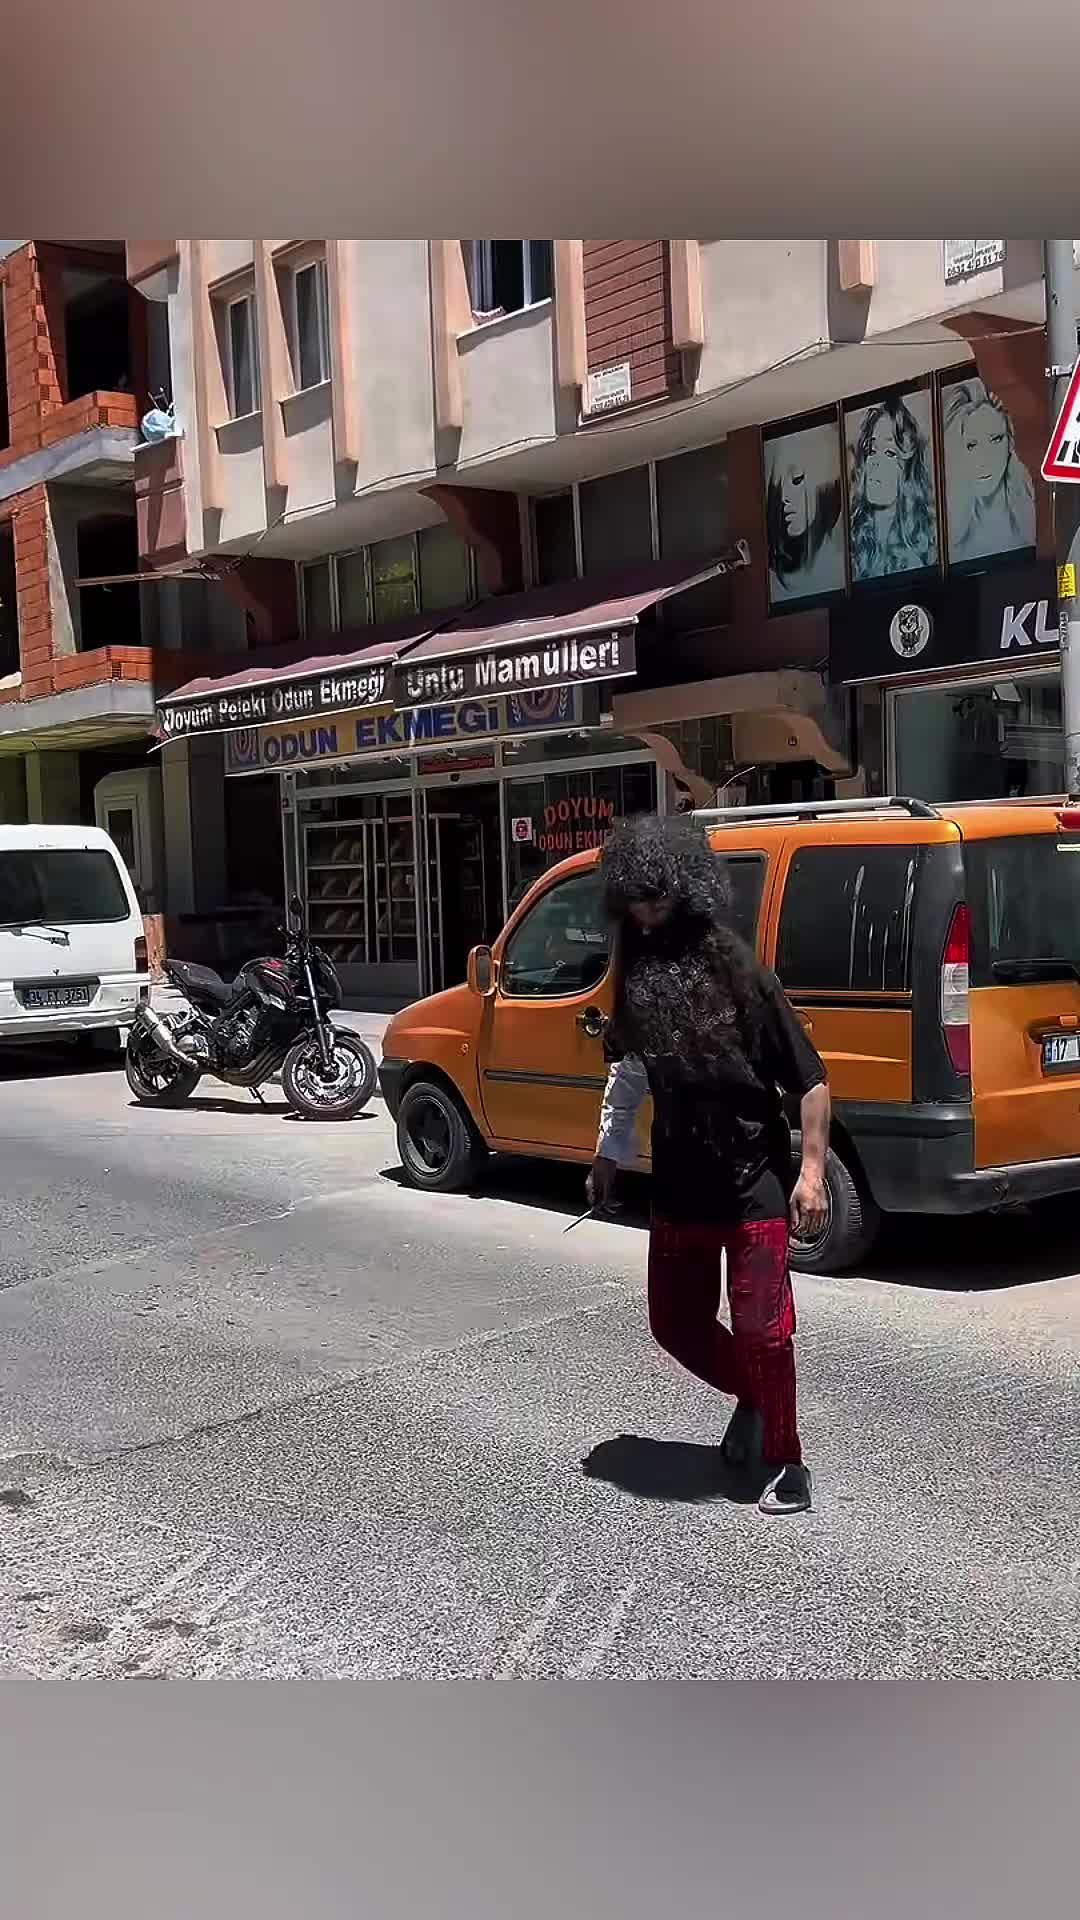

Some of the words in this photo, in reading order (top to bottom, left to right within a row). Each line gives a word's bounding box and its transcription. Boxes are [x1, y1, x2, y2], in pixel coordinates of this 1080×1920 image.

[475, 632, 620, 687] Mamülleri
[164, 705, 214, 731] Doyum
[272, 686, 313, 712] Odun
[320, 667, 385, 704] Ekmeği
[263, 725, 338, 763] ODUN
[544, 797, 614, 826] DOYUM
